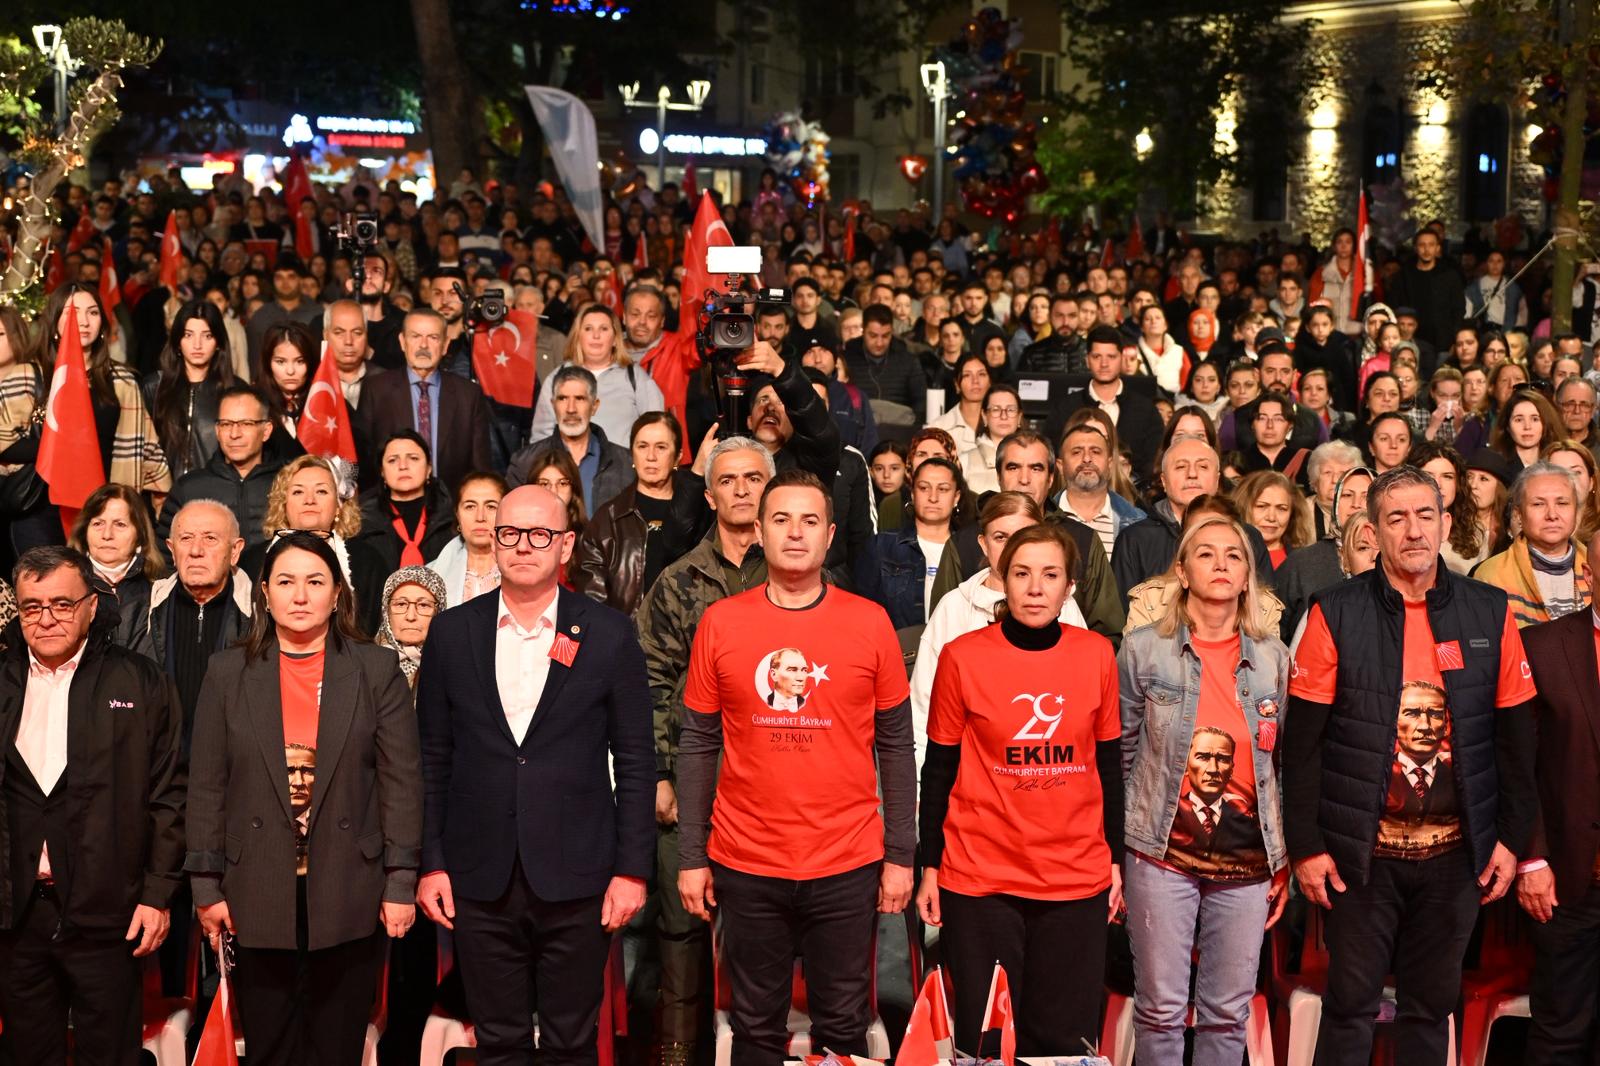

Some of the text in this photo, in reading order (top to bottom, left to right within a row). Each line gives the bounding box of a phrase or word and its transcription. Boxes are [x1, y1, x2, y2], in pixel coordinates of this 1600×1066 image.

[752, 714, 832, 726] CUMHURİYET BAYRAMI
[1011, 693, 1065, 740] 29
[770, 730, 813, 743] 29 EKİM
[1006, 741, 1074, 765] EKİM
[993, 766, 1049, 776] CUMHURİYET
